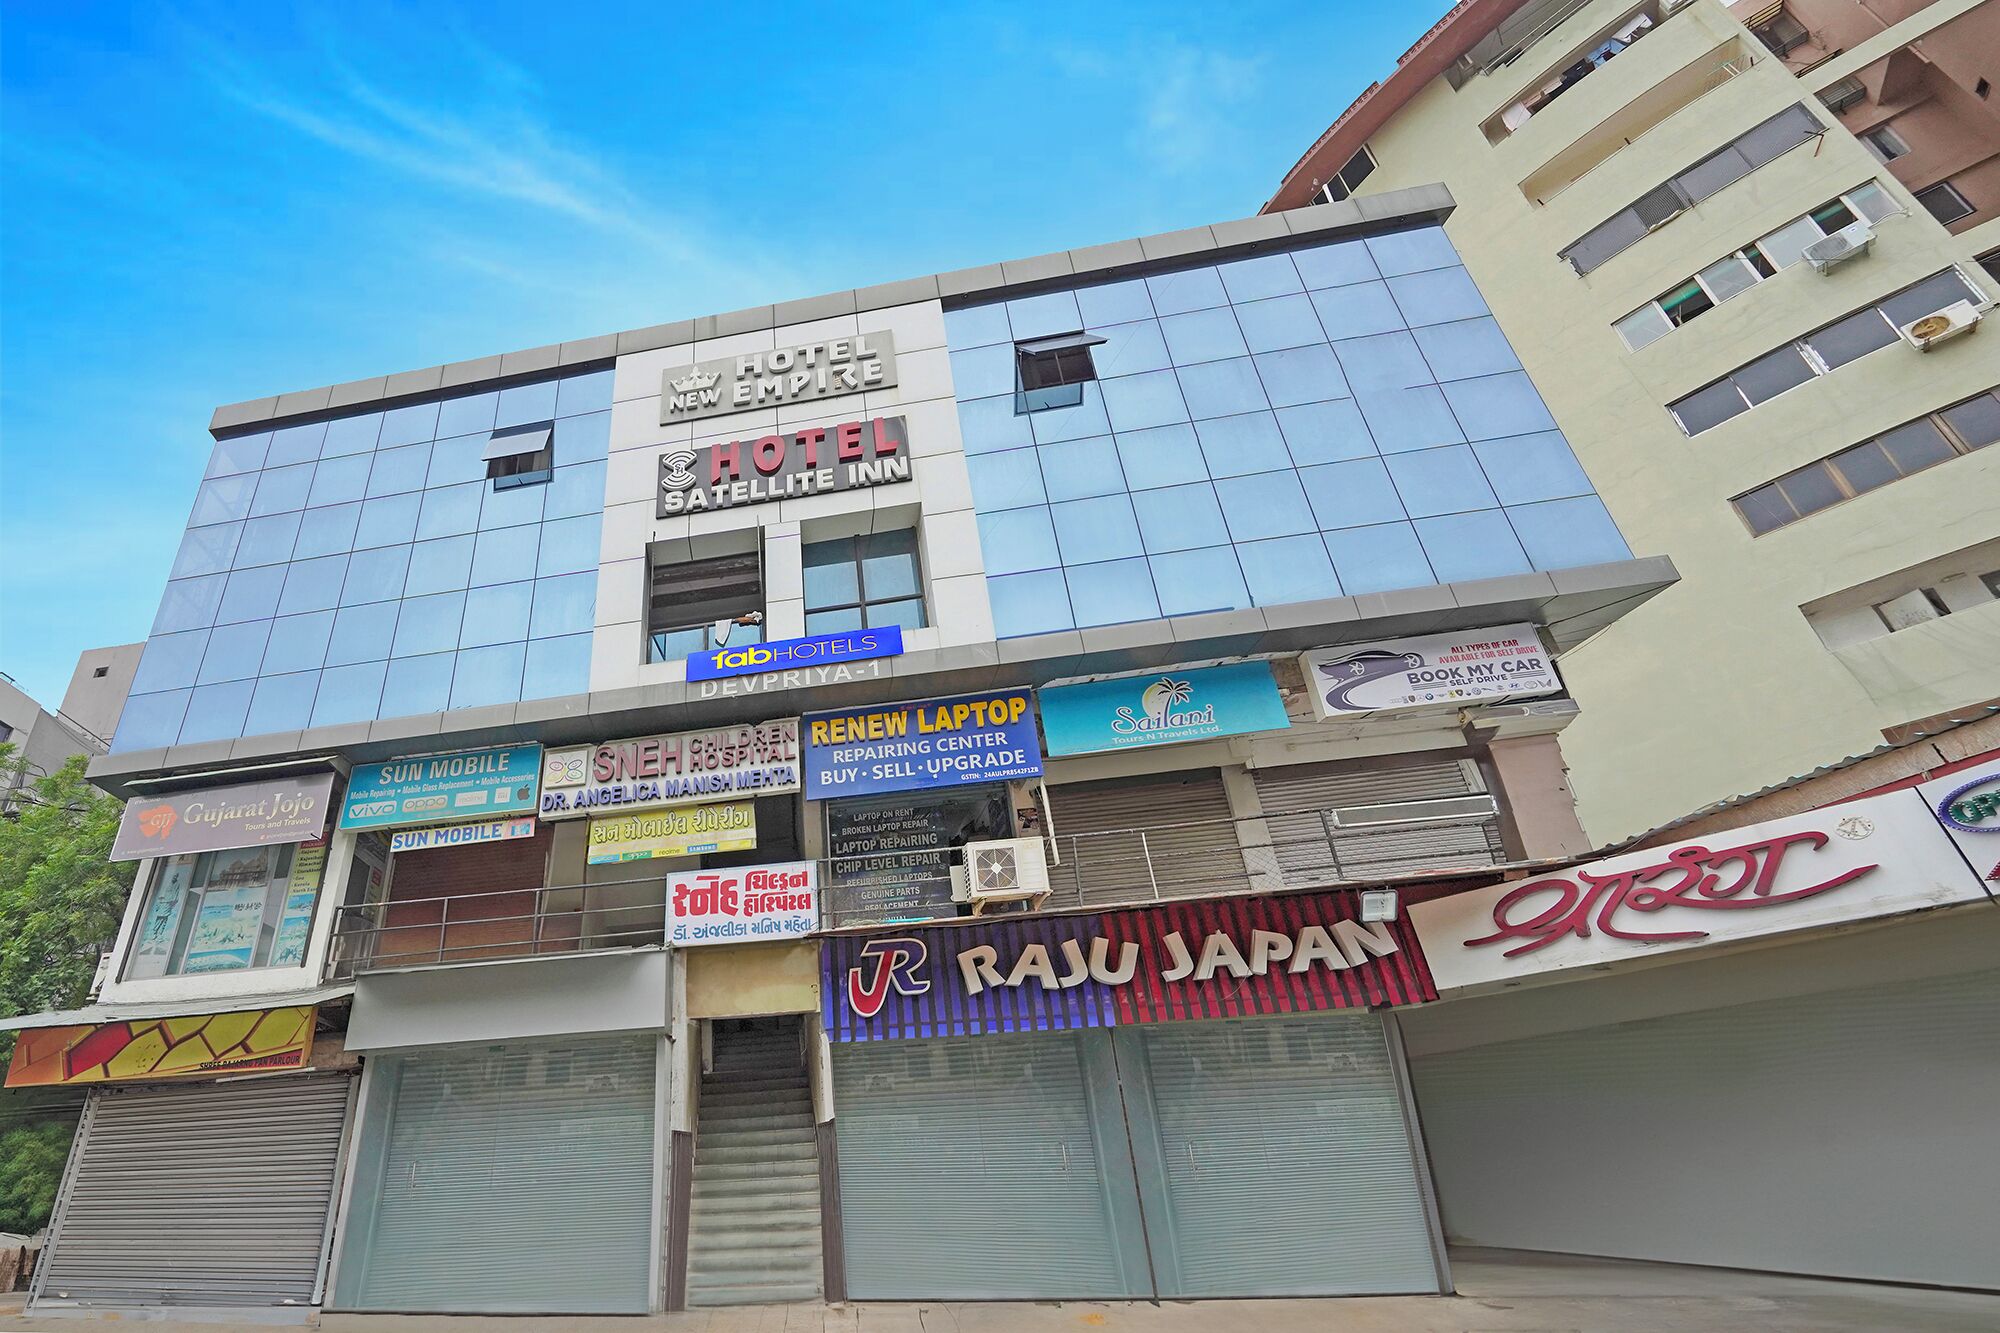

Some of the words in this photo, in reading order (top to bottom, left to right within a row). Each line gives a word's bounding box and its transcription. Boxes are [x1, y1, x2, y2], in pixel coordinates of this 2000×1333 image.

[736, 336, 877, 380] HOTEL
[669, 388, 722, 413] NEW
[733, 358, 884, 407] EMPIRE
[710, 417, 899, 485] HOTEL
[664, 467, 835, 513] SATELLITE
[849, 456, 909, 487] INN
[711, 635, 878, 670] fabHOTELS
[1439, 653, 1480, 664] AVAILABLE
[1481, 650, 1496, 659] FOR
[1497, 648, 1515, 657] SELF
[1516, 645, 1539, 654] DRIVE
[1466, 642, 1490, 651] TYPES
[1491, 641, 1500, 649] OF
[1502, 639, 1519, 647] CAR
[701, 660, 881, 698] DEVPRIYA-1
[1406, 667, 1464, 684] BOOK
[1469, 663, 1495, 676] MY
[1501, 658, 1543, 673] CAR
[1449, 678, 1474, 687] SELF
[1477, 673, 1508, 683] DRIVE
[811, 710, 908, 747] RENEW
[917, 697, 1026, 735] LAPTOP
[1112, 703, 1216, 735] Sailani
[688, 724, 796, 754] CHILDREN
[832, 740, 931, 763] REPAIRING
[936, 732, 1008, 751] CENTER
[1112, 733, 1144, 745] Tours
[1146, 732, 1156, 740] N
[1157, 728, 1198, 740] Travels
[1200, 725, 1223, 734] Ltd.
[379, 762, 424, 785] SUN
[430, 753, 511, 780] MOBILE
[593, 738, 683, 782] SNEH
[689, 744, 797, 772] HOSPITAL
[820, 768, 859, 785] BUY
[872, 761, 916, 779] SELL
[927, 749, 1026, 774] UPGRADE
[351, 791, 369, 799] Mobile
[370, 789, 395, 799] Repairing
[402, 785, 421, 794] Mobile
[422, 783, 437, 792] Glass
[438, 780, 474, 791] Replacement
[481, 777, 500, 786] Mobile
[501, 773, 535, 784] Accessories
[541, 792, 570, 812] DR.
[573, 782, 661, 808] ANGELICA
[665, 774, 733, 797] MANISH
[736, 766, 796, 788] MEHTA
[183, 799, 266, 828] Gujarat
[266, 792, 315, 822] Jojo
[351, 804, 395, 817] vivo
[405, 797, 447, 809] oppo
[853, 811, 880, 822] LAPTOP
[882, 810, 893, 818] ON
[895, 808, 914, 817] RENT
[245, 823, 265, 832] Tours
[267, 820, 282, 829] and
[284, 817, 311, 826] Travels
[392, 831, 429, 849] SUN
[434, 823, 503, 845] MOBILE
[842, 825, 871, 836] BROKEN
[873, 822, 901, 832] LAPTOP
[902, 819, 929, 829] REPAIR
[836, 839, 877, 854] LAPTOP
[880, 833, 938, 850] REPAIRING
[836, 861, 862, 874] CHIP
[865, 857, 900, 872] LEVEL
[901, 852, 942, 868] REPAIR
[900, 871, 933, 881] LAPTOPS
[861, 888, 895, 900] GENUINE
[897, 886, 921, 896] PARTS
[957, 936, 1140, 996] RAJU
[1161, 918, 1400, 983] JAPAN
[269, 1055, 301, 1066] PARLOUR
